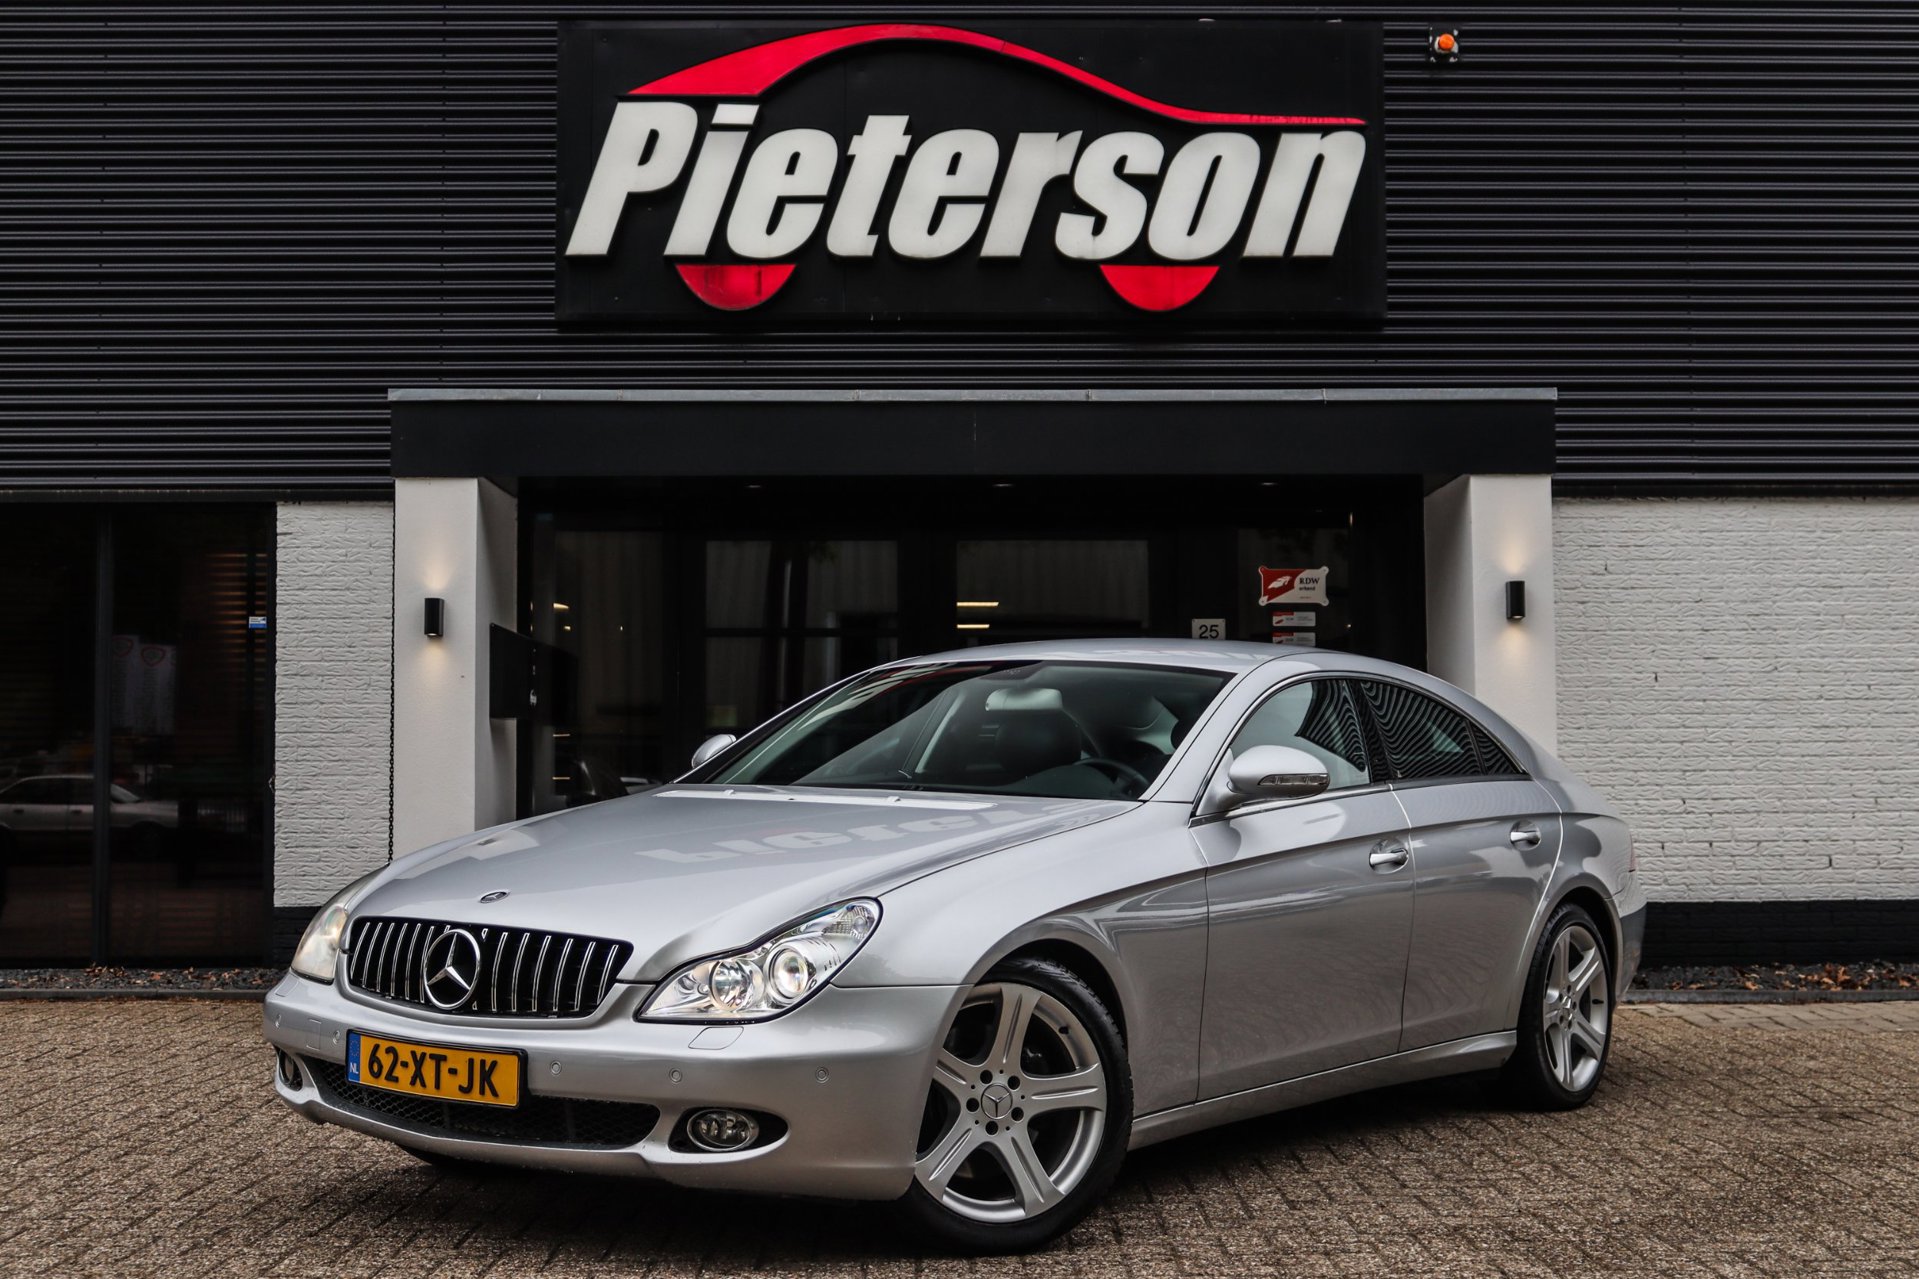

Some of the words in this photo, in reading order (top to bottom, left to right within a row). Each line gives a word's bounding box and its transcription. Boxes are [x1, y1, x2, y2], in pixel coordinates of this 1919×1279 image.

[565, 101, 1367, 261] Pieterson
[1299, 577, 1320, 585] RDW
[1199, 624, 1220, 639] 25
[349, 1062, 359, 1075] NL
[368, 1043, 499, 1098] 62-XT-JK
